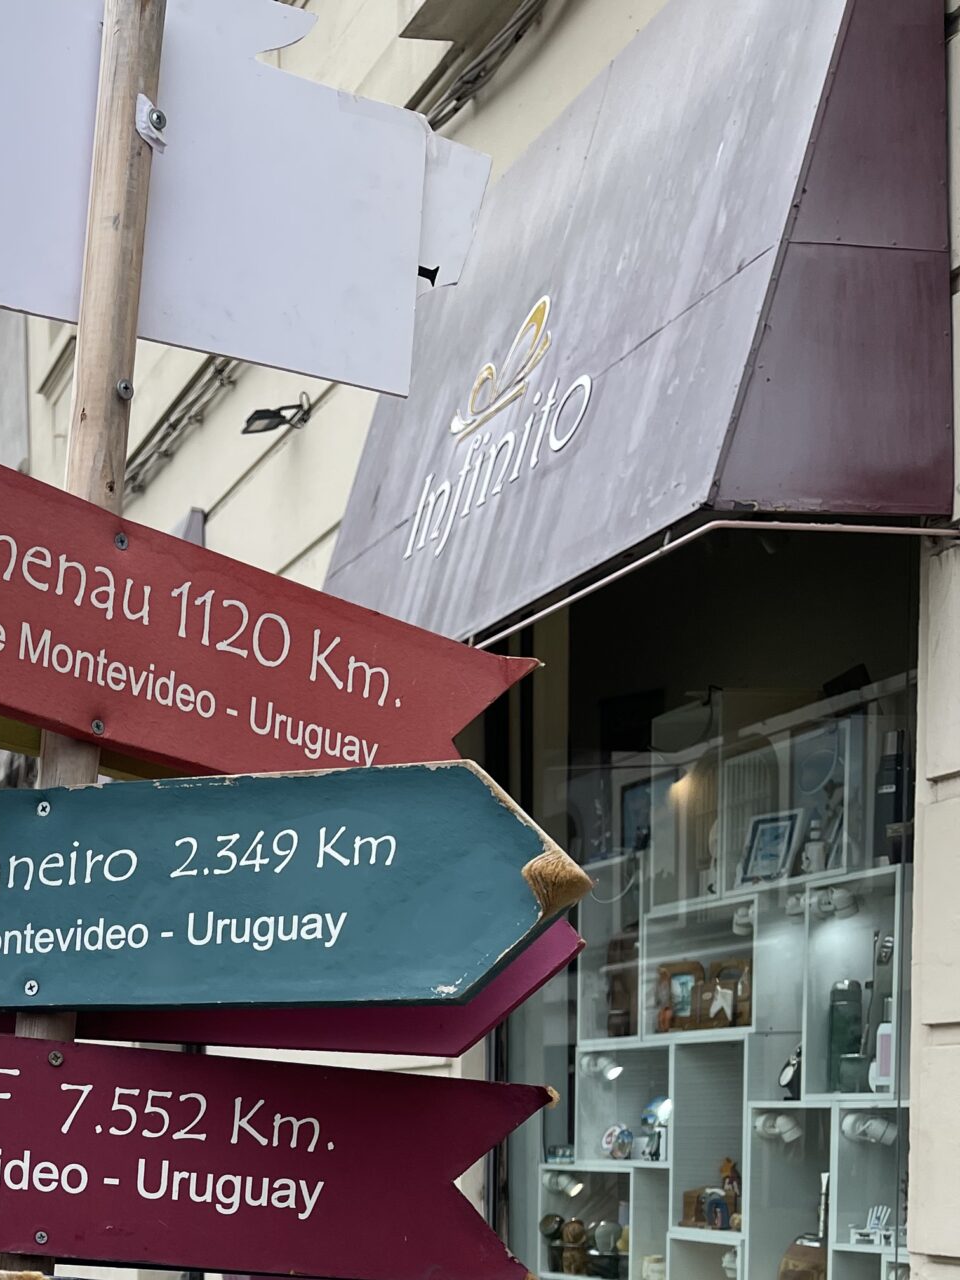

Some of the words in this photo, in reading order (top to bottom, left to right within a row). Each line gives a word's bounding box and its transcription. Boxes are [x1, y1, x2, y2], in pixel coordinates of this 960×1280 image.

[402, 374, 592, 560] Infinito
[171, 580, 291, 669] 1120
[309, 628, 402, 709] Km.
[18, 621, 216, 719] Montevideo
[249, 696, 379, 768] Uruguay
[169, 829, 299, 878] 2.349
[316, 825, 397, 868] Km
[187, 911, 348, 951] Uruguay
[59, 1083, 207, 1141] 7.552
[230, 1097, 335, 1152] Km.
[137, 1158, 325, 1220] Uruguay
